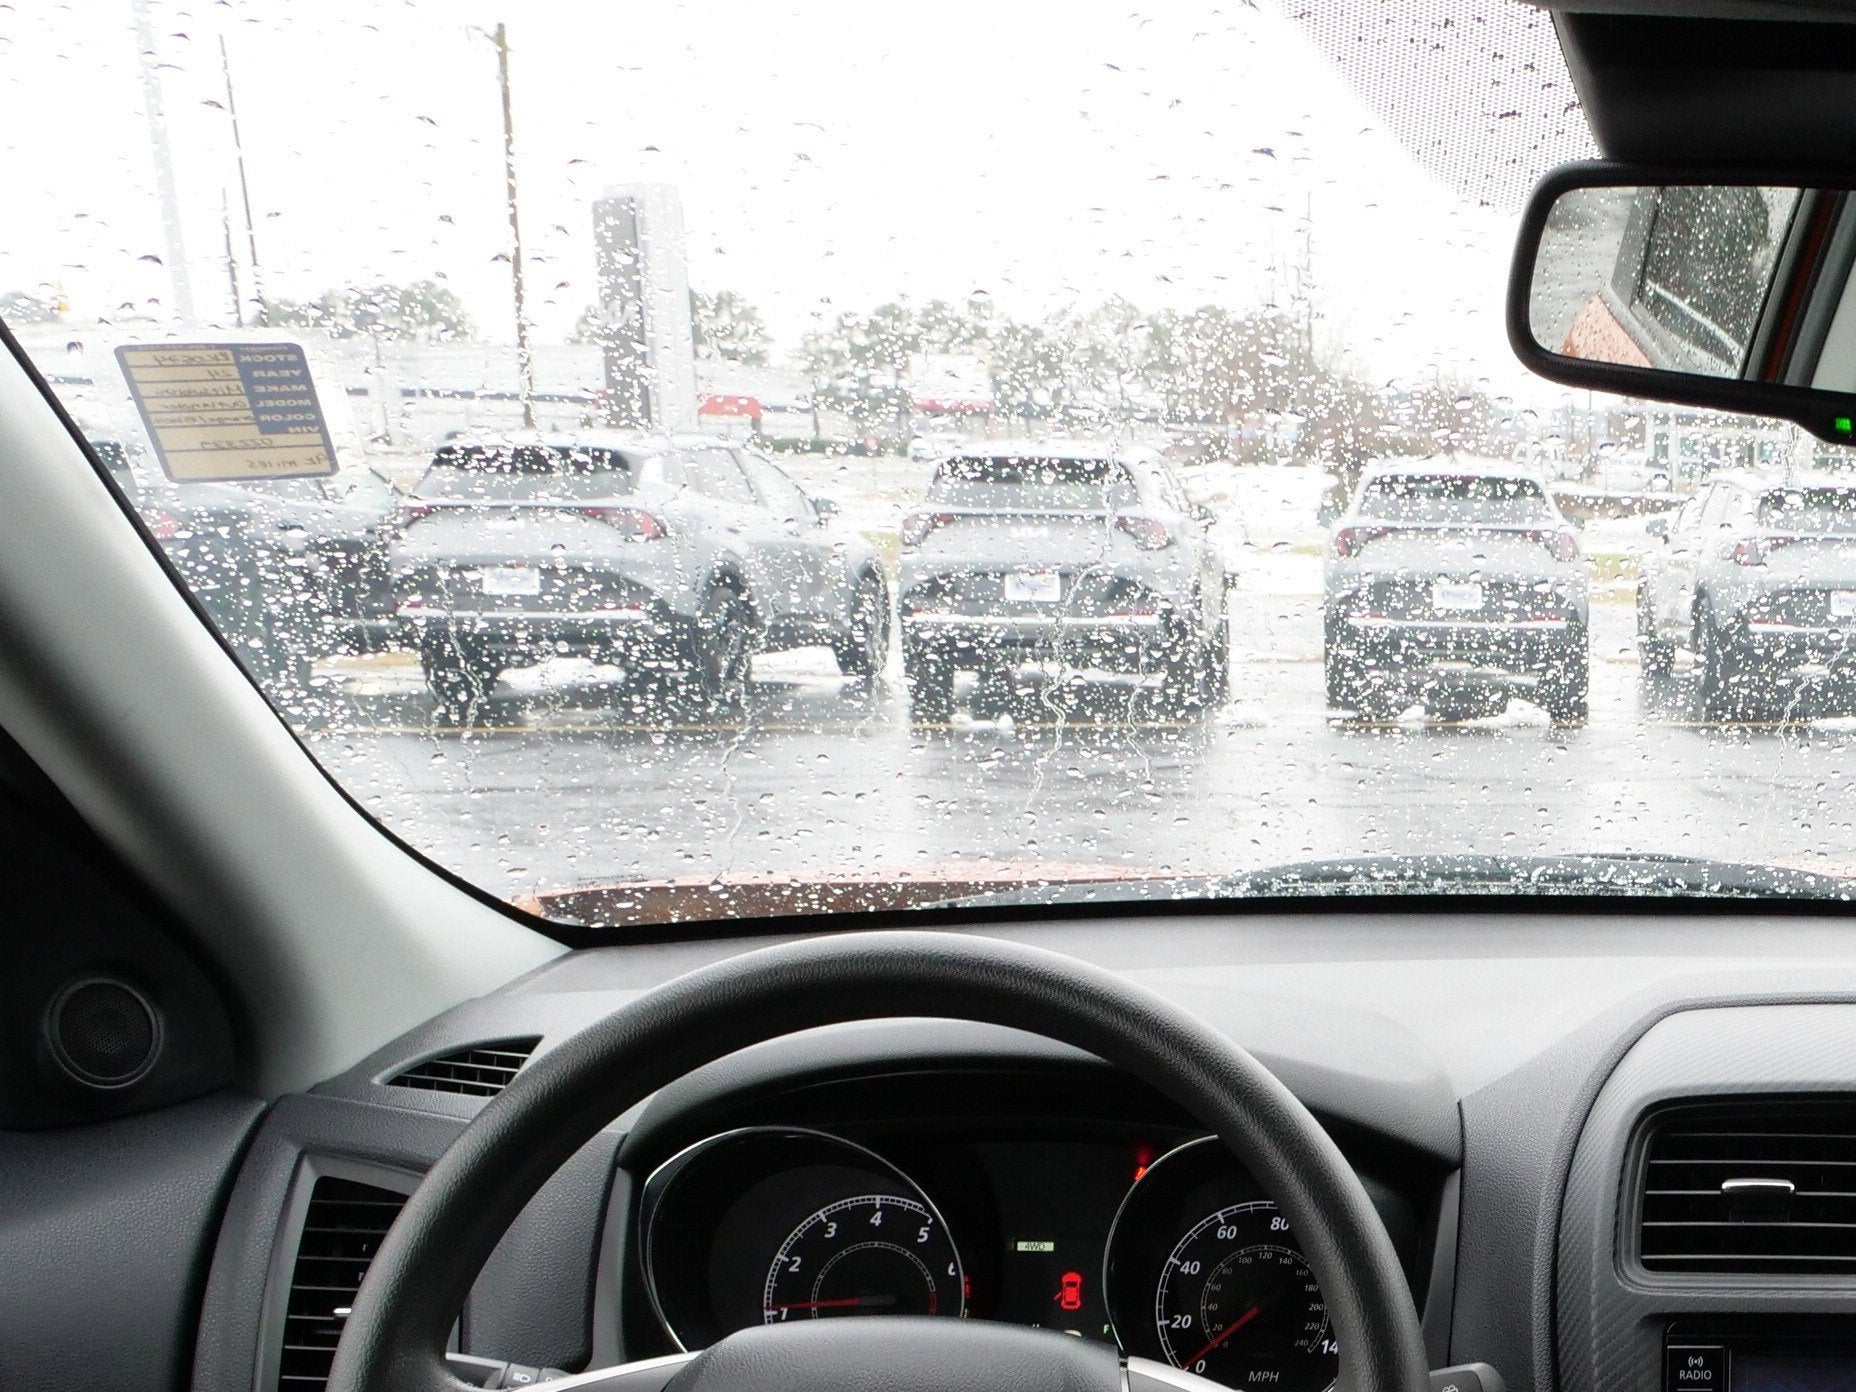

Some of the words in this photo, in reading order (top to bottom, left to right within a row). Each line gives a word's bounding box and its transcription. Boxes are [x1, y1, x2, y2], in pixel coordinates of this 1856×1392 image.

[869, 1211, 883, 1227] 4
[824, 1222, 837, 1238] 3
[917, 1227, 930, 1242] 5
[1217, 1226, 1237, 1240] 60
[788, 1257, 802, 1272] 2
[1279, 1257, 1293, 1265] 140
[1180, 1261, 1200, 1275] 40
[1222, 1267, 1233, 1275] 80
[1296, 1269, 1309, 1277] 160
[1211, 1283, 1222, 1291] 60
[1208, 1303, 1218, 1311] 40
[1309, 1303, 1323, 1311] 200
[780, 1307, 788, 1320] 1
[1171, 1315, 1192, 1329] 20
[1103, 1324, 1110, 1335] F
[1294, 1339, 1309, 1347] 240
[1321, 1339, 1338, 1354] 14
[1195, 1359, 1206, 1374] 0
[1248, 1371, 1280, 1383] MPH
[1679, 1370, 1712, 1380] RADIO
